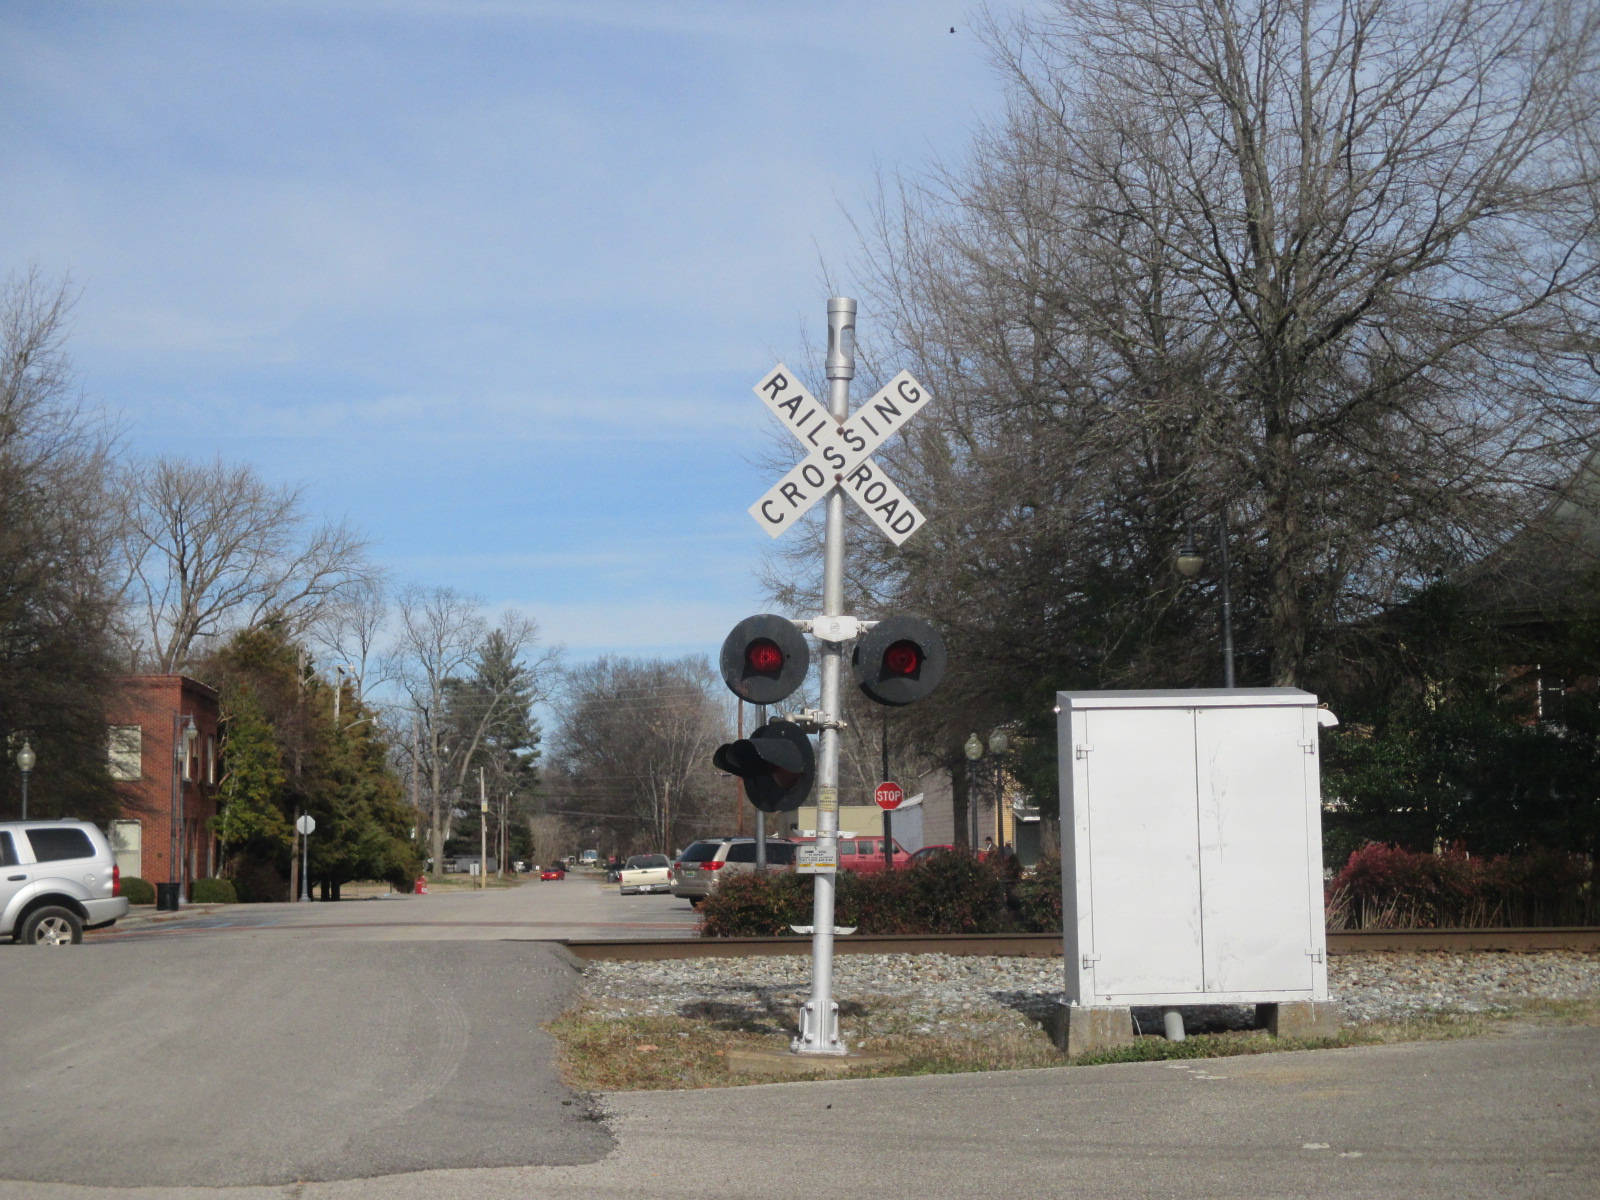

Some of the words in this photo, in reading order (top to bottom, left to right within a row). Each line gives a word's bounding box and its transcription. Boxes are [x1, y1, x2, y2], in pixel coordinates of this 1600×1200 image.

[761, 380, 921, 524] CROSSING
[763, 373, 826, 446] RAIL
[847, 465, 915, 534] ROAD
[877, 791, 901, 802] STOP
